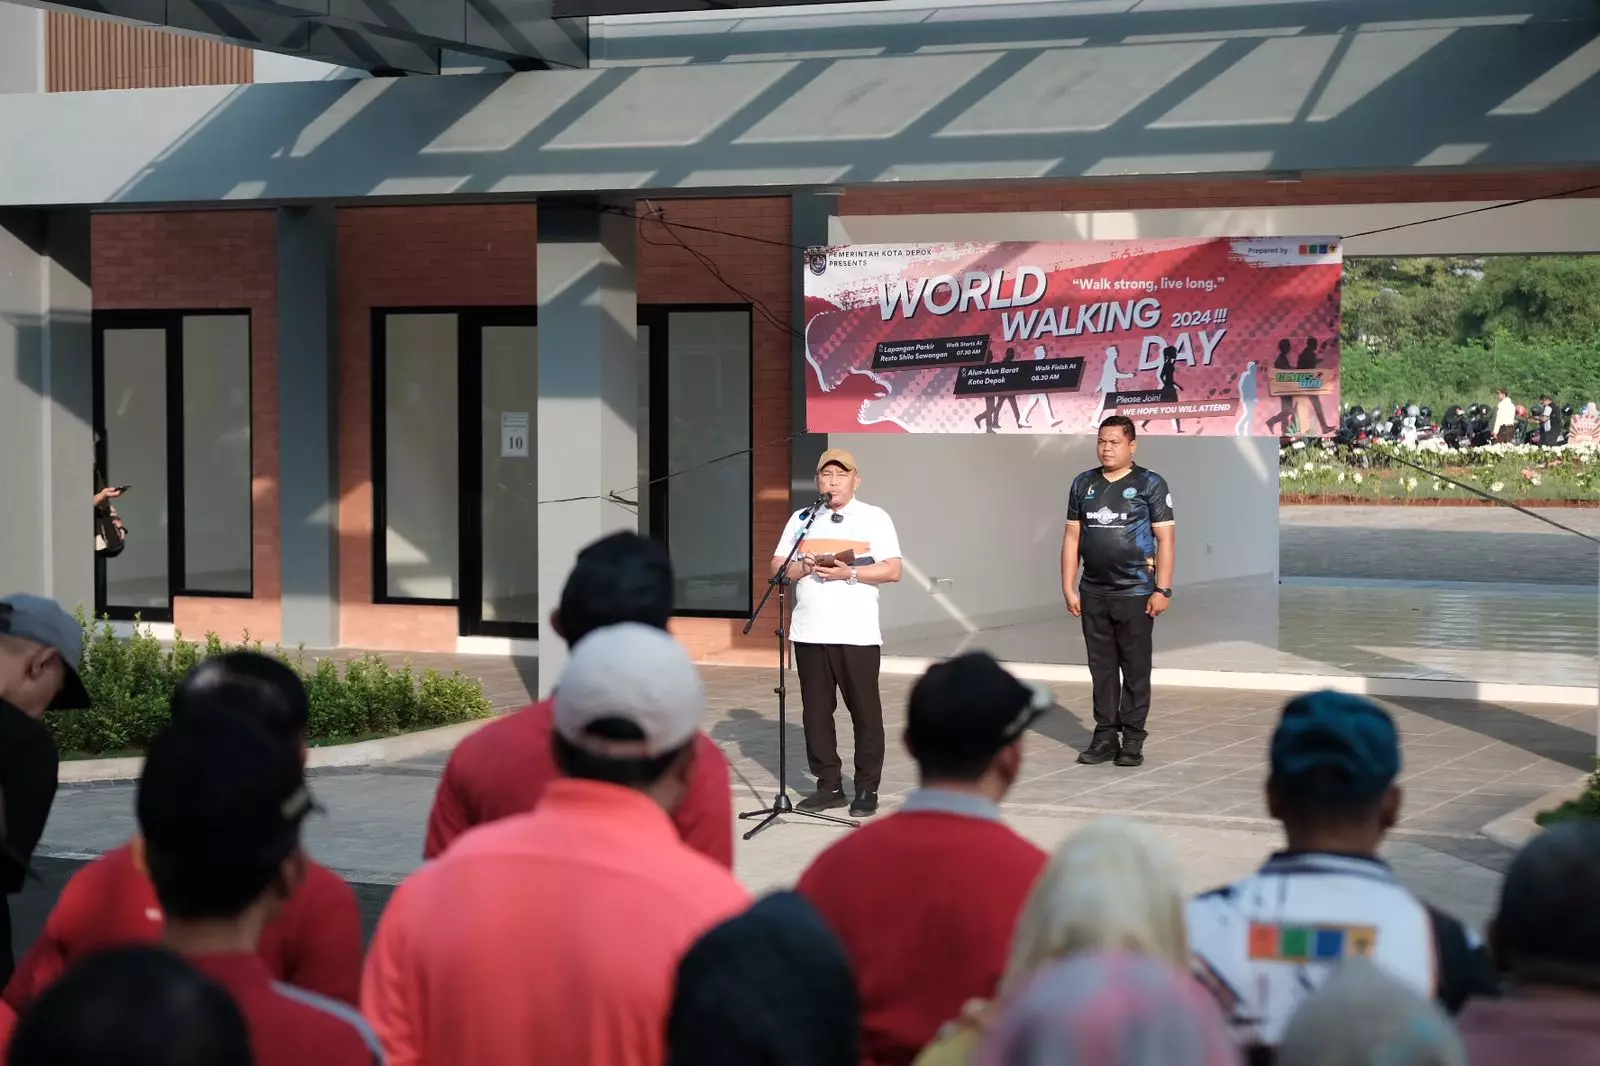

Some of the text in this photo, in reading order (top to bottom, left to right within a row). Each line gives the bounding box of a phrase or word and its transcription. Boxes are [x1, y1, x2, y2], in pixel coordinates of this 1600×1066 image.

[1280, 246, 1289, 254] by
[1072, 277, 1225, 292] “Walk strong, live long.”
[879, 265, 1047, 321] WORLD
[1001, 298, 1162, 342] WALKING
[1171, 311, 1211, 328] 2024
[884, 343, 935, 354] Lapangan Parkir
[1138, 328, 1227, 371] DAY
[899, 353, 914, 361] Shila
[915, 352, 948, 360] Sawangan
[967, 366, 1019, 376] Alun-Alun Barat
[968, 376, 1006, 386] Kota Depok
[1115, 394, 1161, 404] Please Join!
[1123, 403, 1231, 416] WE HOPE YOU WILL ATTEND
[508, 436, 523, 450] 10
